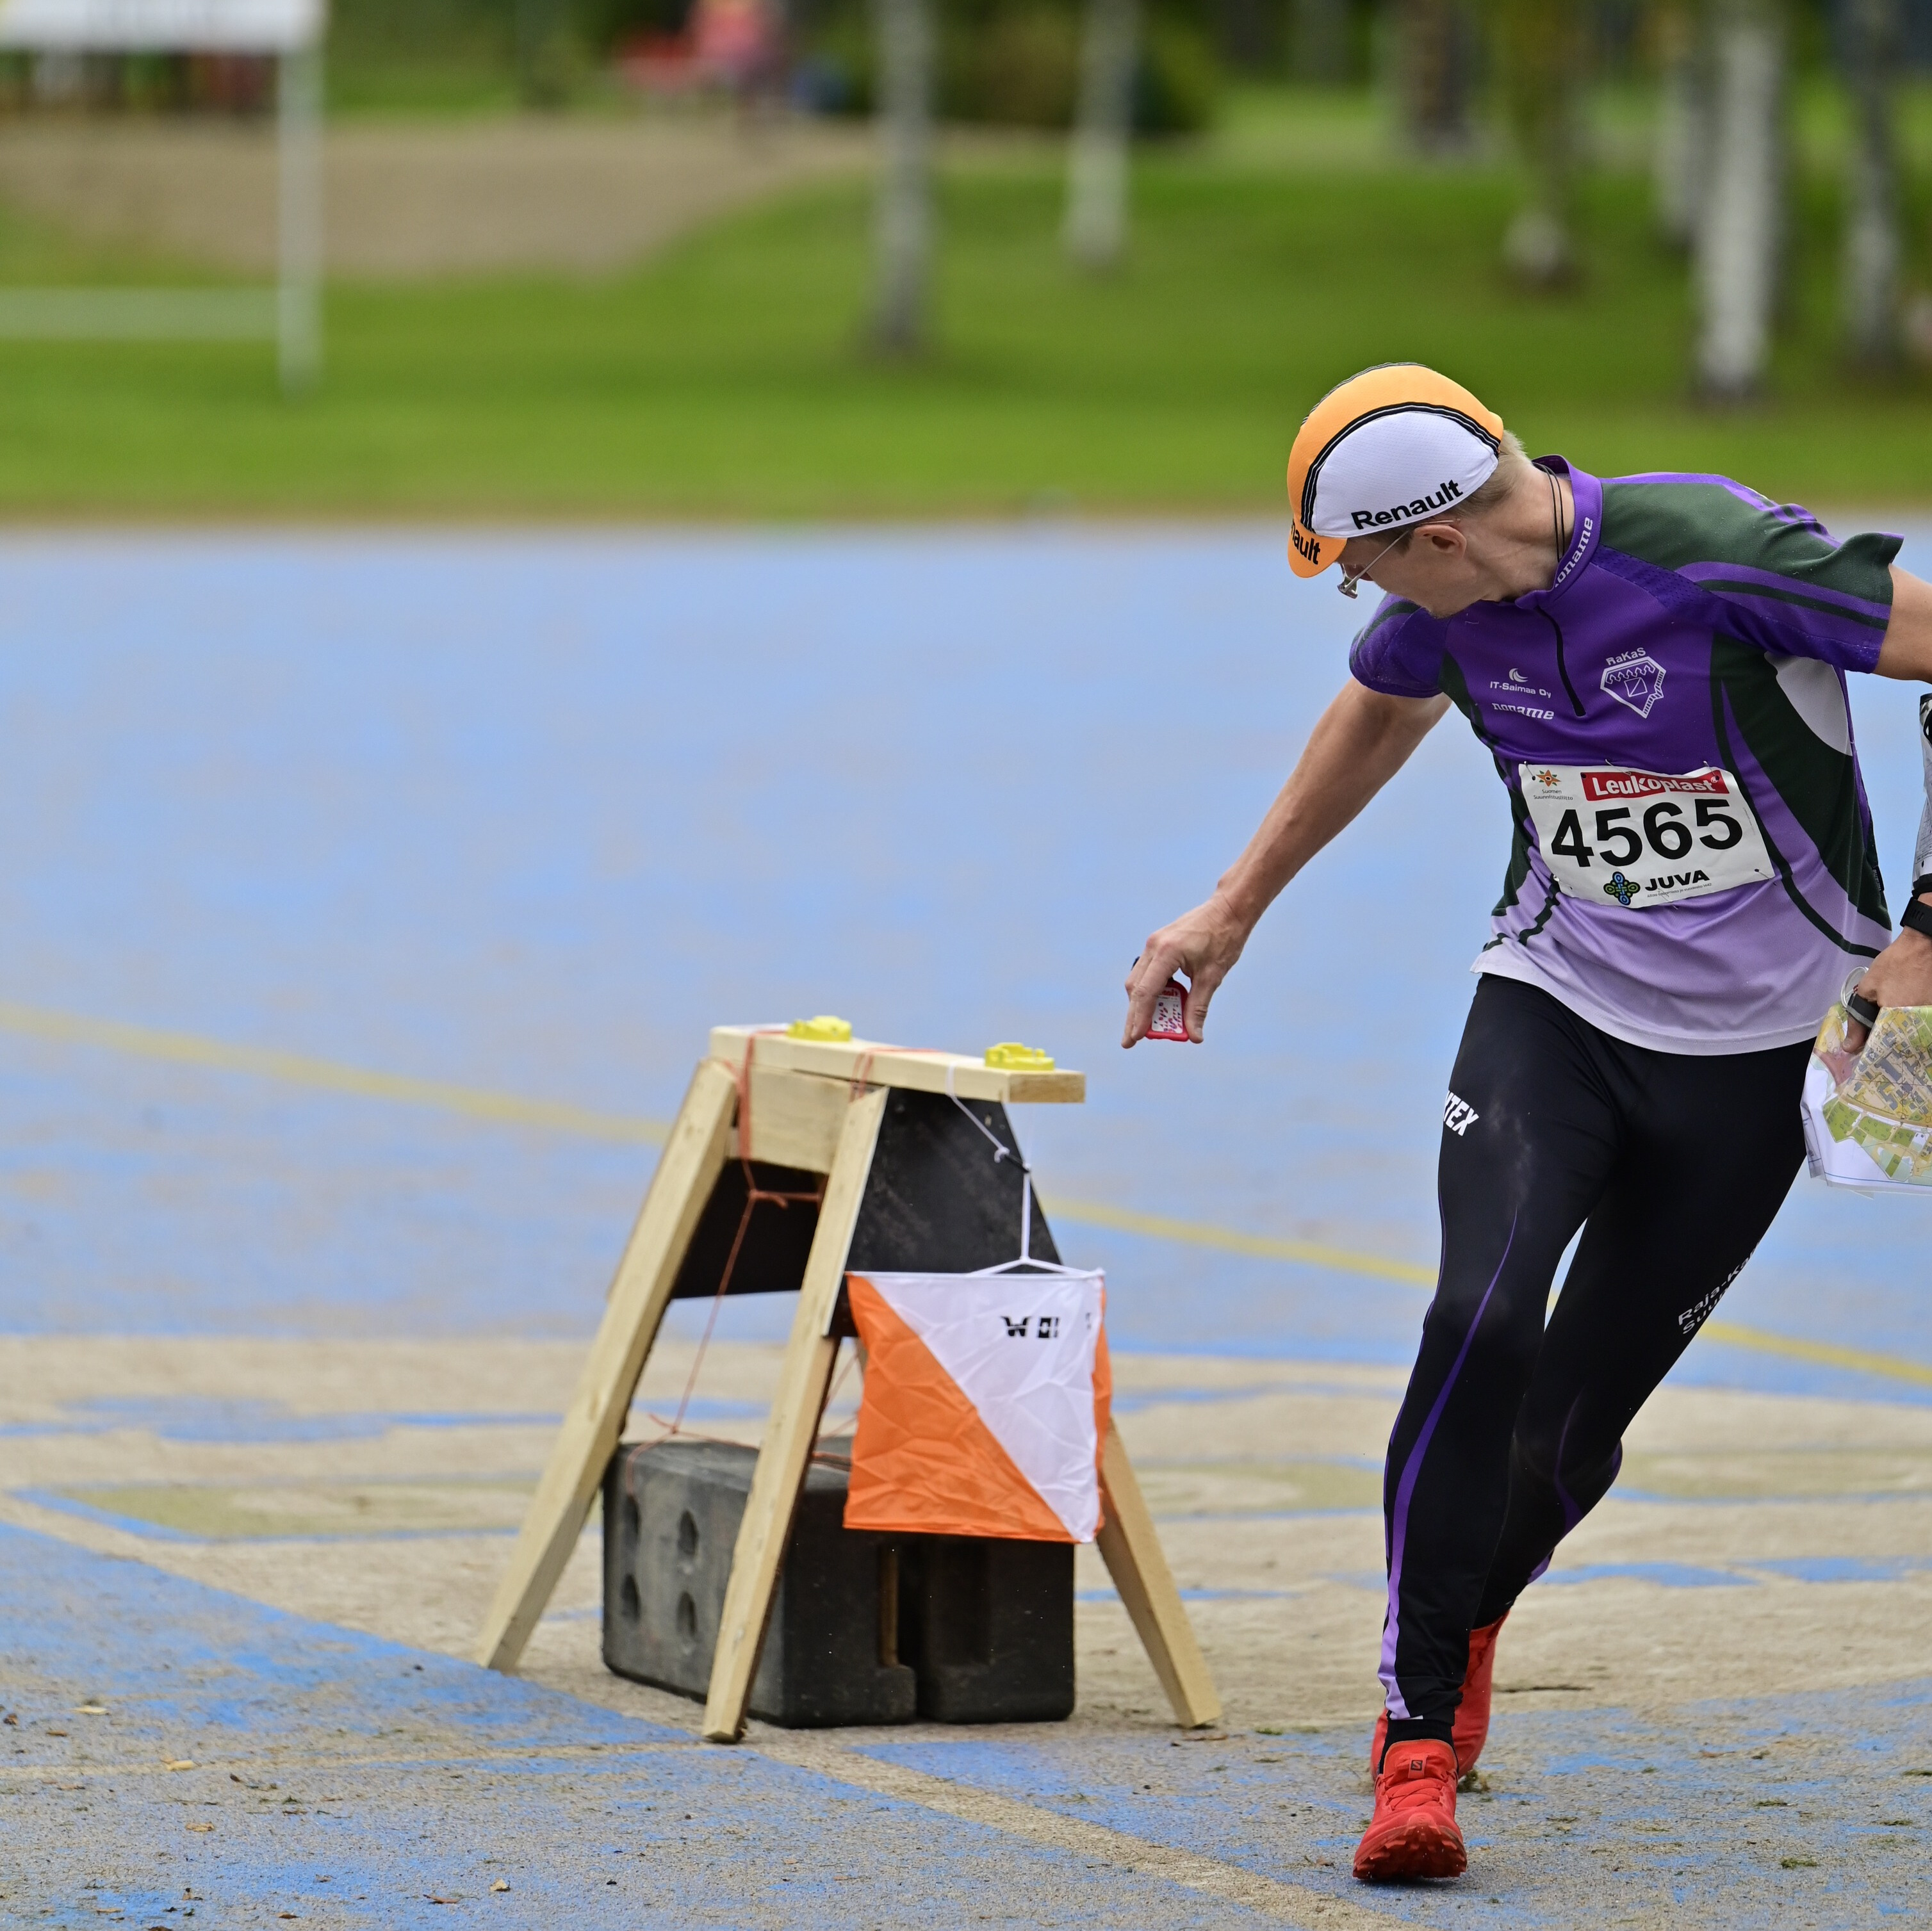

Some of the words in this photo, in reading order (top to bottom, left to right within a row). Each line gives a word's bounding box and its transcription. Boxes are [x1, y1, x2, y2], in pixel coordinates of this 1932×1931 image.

[1351, 480, 1463, 530] Renault
[1605, 647, 1646, 665] RaKaS
[1489, 681, 1536, 695] IT-Saimaa
[1539, 688, 1551, 698] Oy
[1491, 703, 1555, 720] noname
[1592, 775, 1717, 796] Leukoplast
[1551, 798, 1743, 867] 4565
[1644, 869, 1710, 892] JUVA
